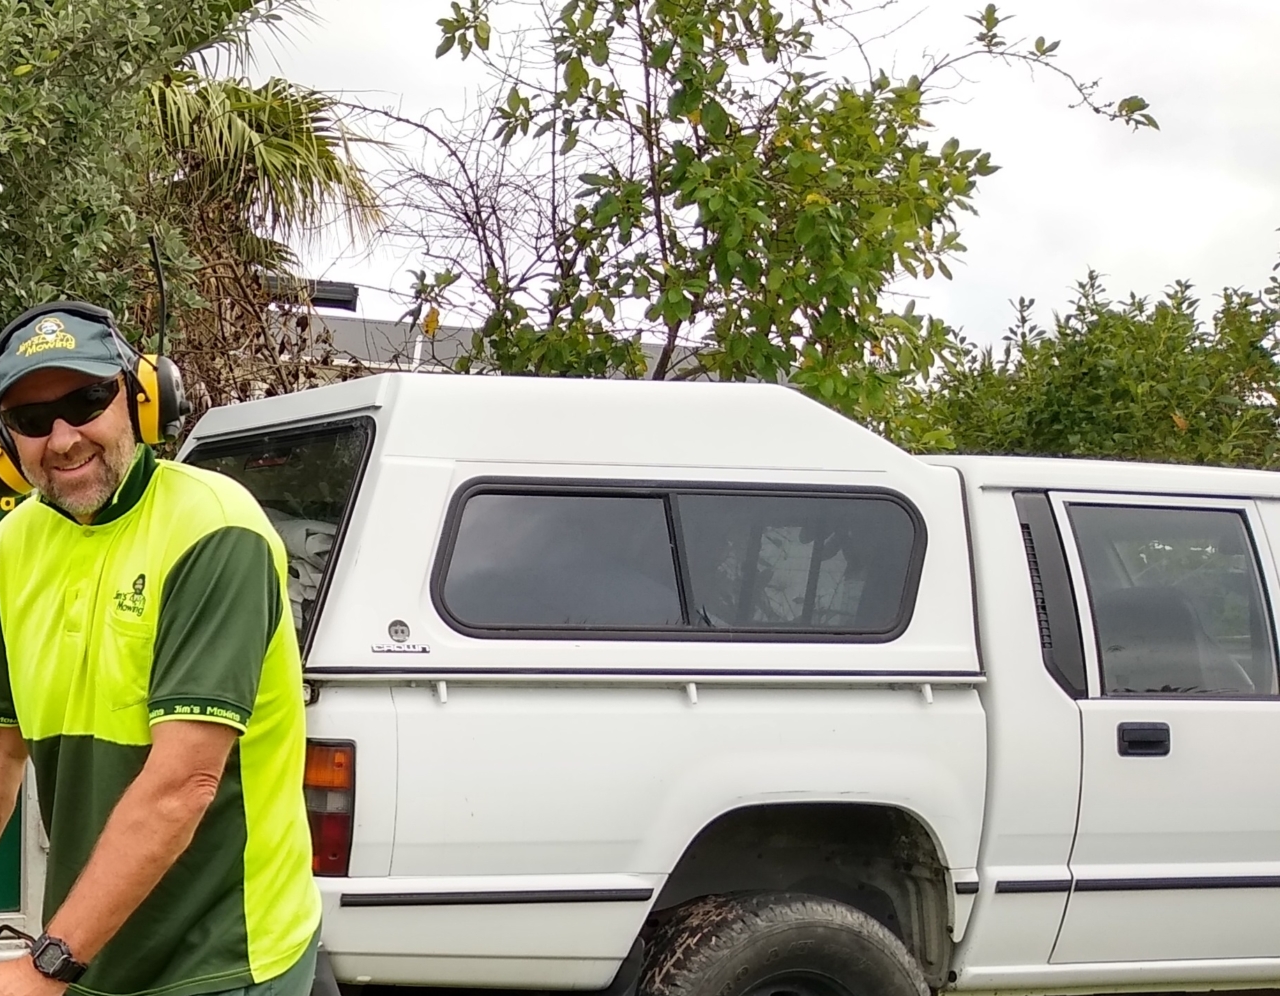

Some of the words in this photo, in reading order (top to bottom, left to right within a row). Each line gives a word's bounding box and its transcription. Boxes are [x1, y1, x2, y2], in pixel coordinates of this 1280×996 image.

[25, 339, 75, 357] Mowing
[116, 600, 144, 617] Mowing
[173, 704, 200, 714] Jim's
[206, 706, 241, 722] Mowing
